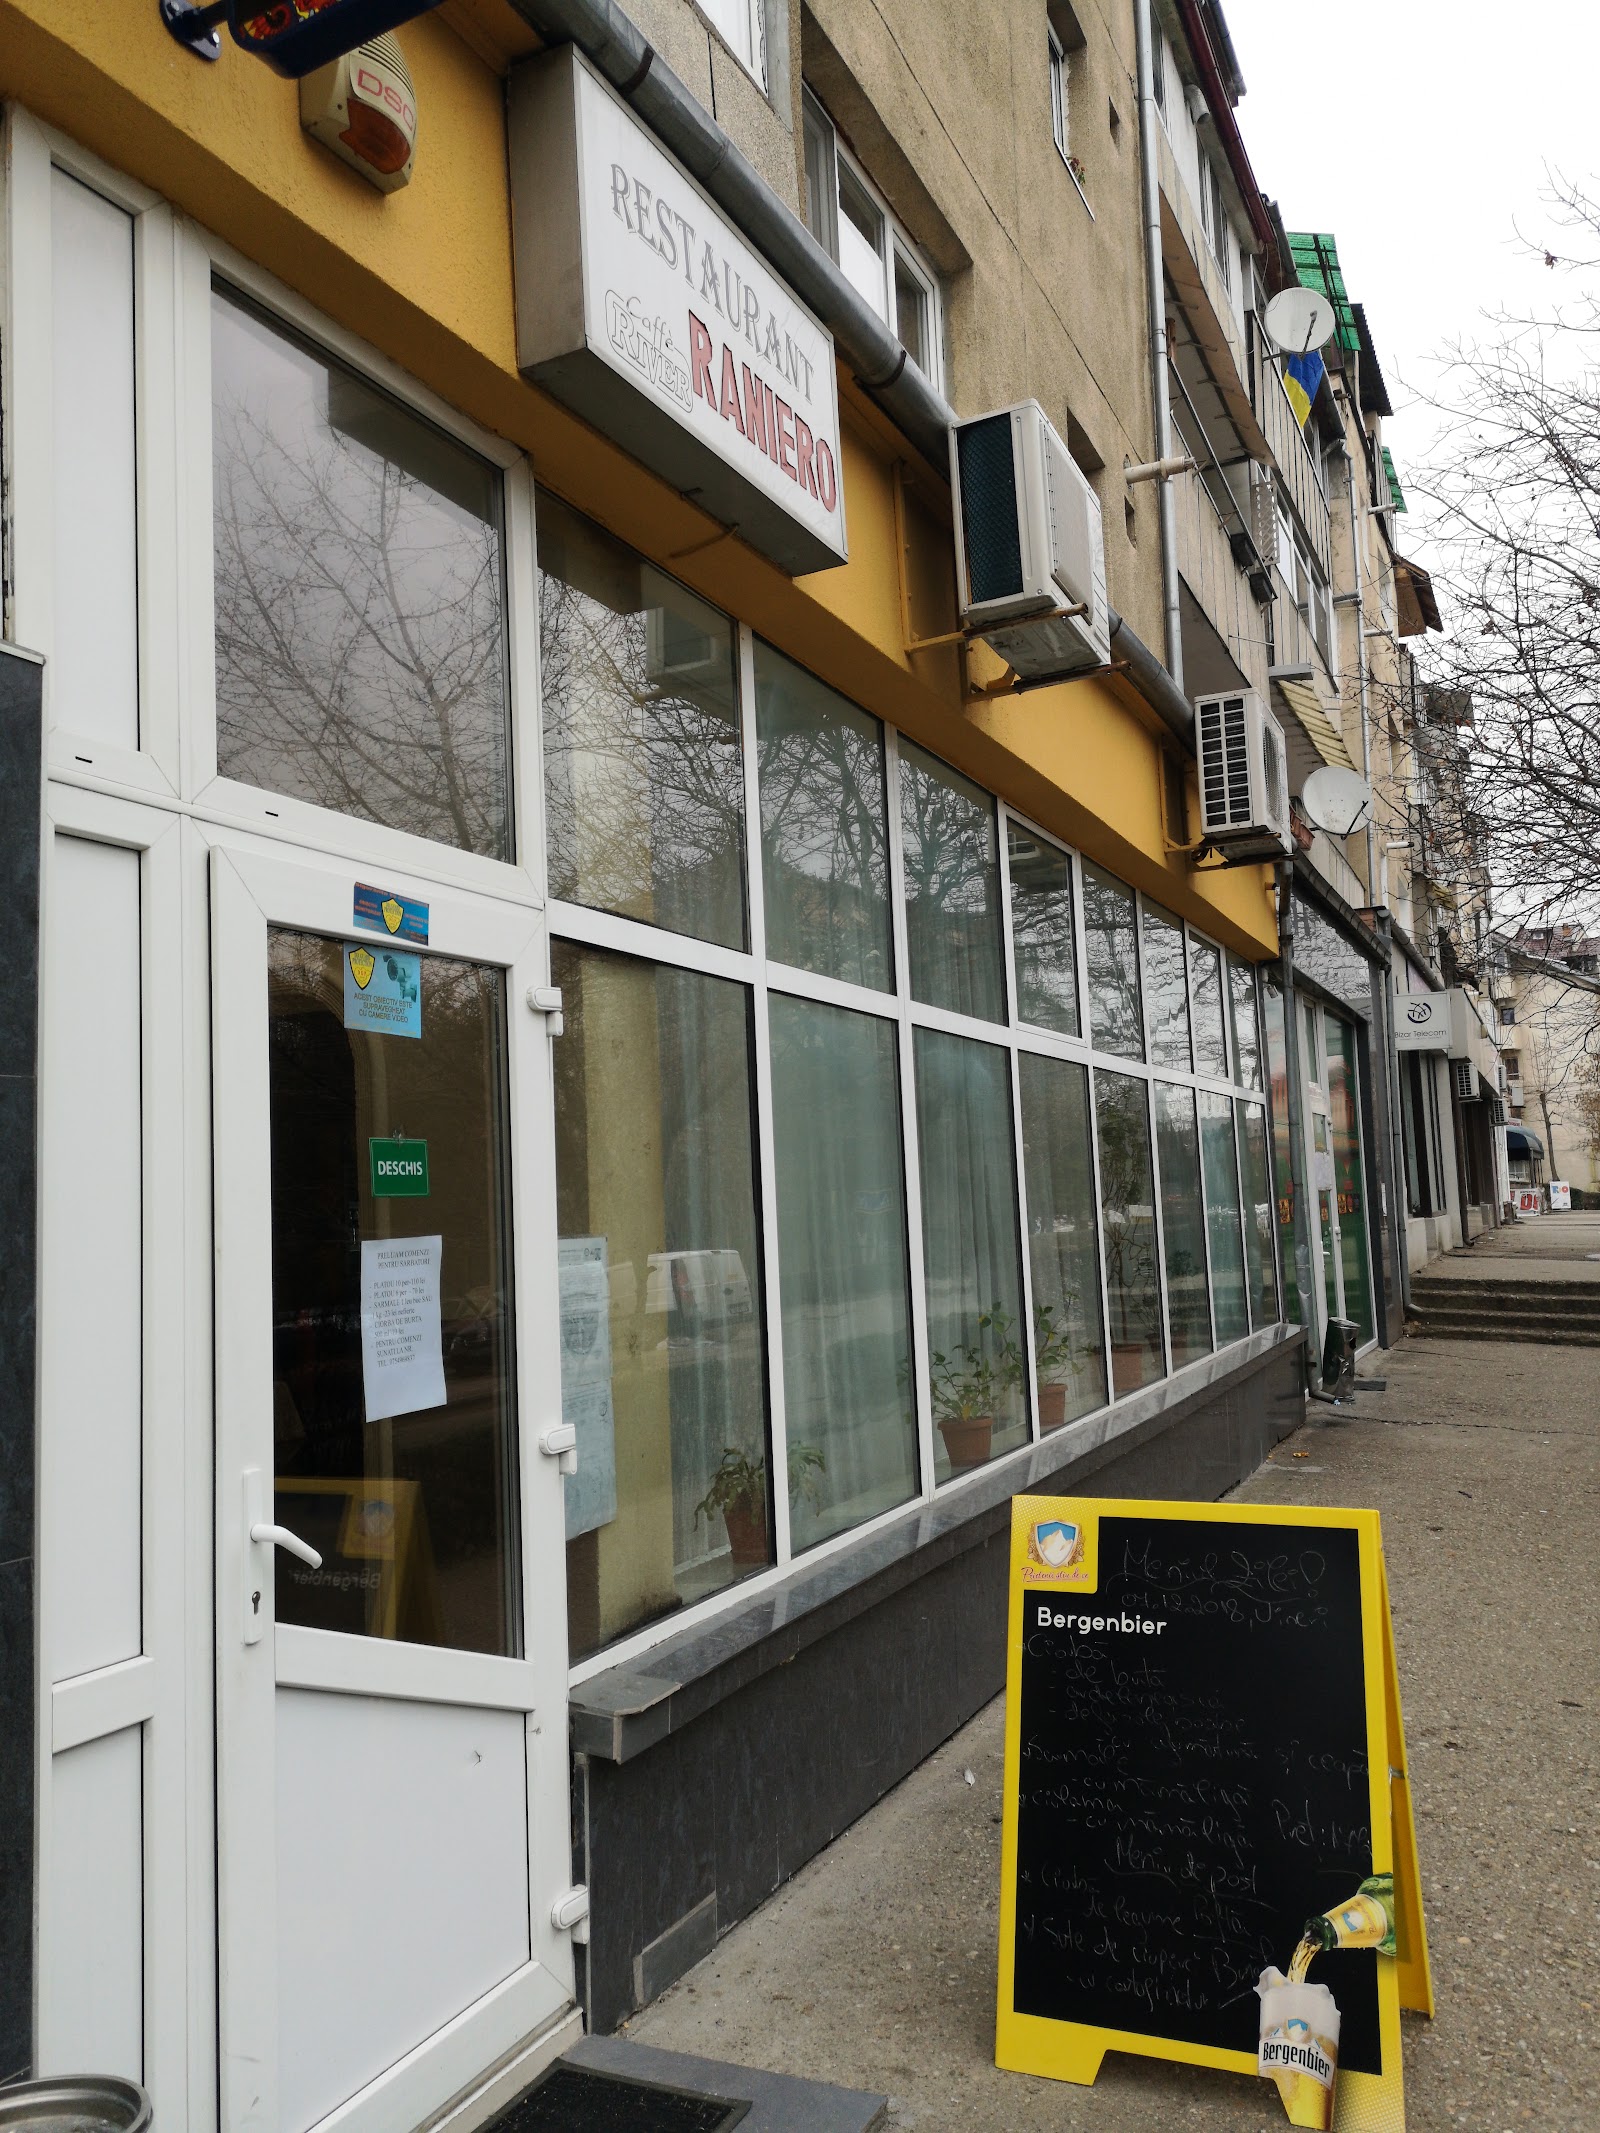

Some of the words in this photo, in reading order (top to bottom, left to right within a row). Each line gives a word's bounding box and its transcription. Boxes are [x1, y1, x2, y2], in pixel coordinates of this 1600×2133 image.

[610, 163, 815, 406] RESTAURANT
[626, 296, 675, 350] Caffè
[612, 301, 692, 408] RIVER
[688, 309, 838, 514] RANIERO
[377, 1160, 423, 1176] DESCHIS
[1037, 1606, 1168, 1635] Bergenbier
[1263, 2041, 1330, 2079] Bergenbier
